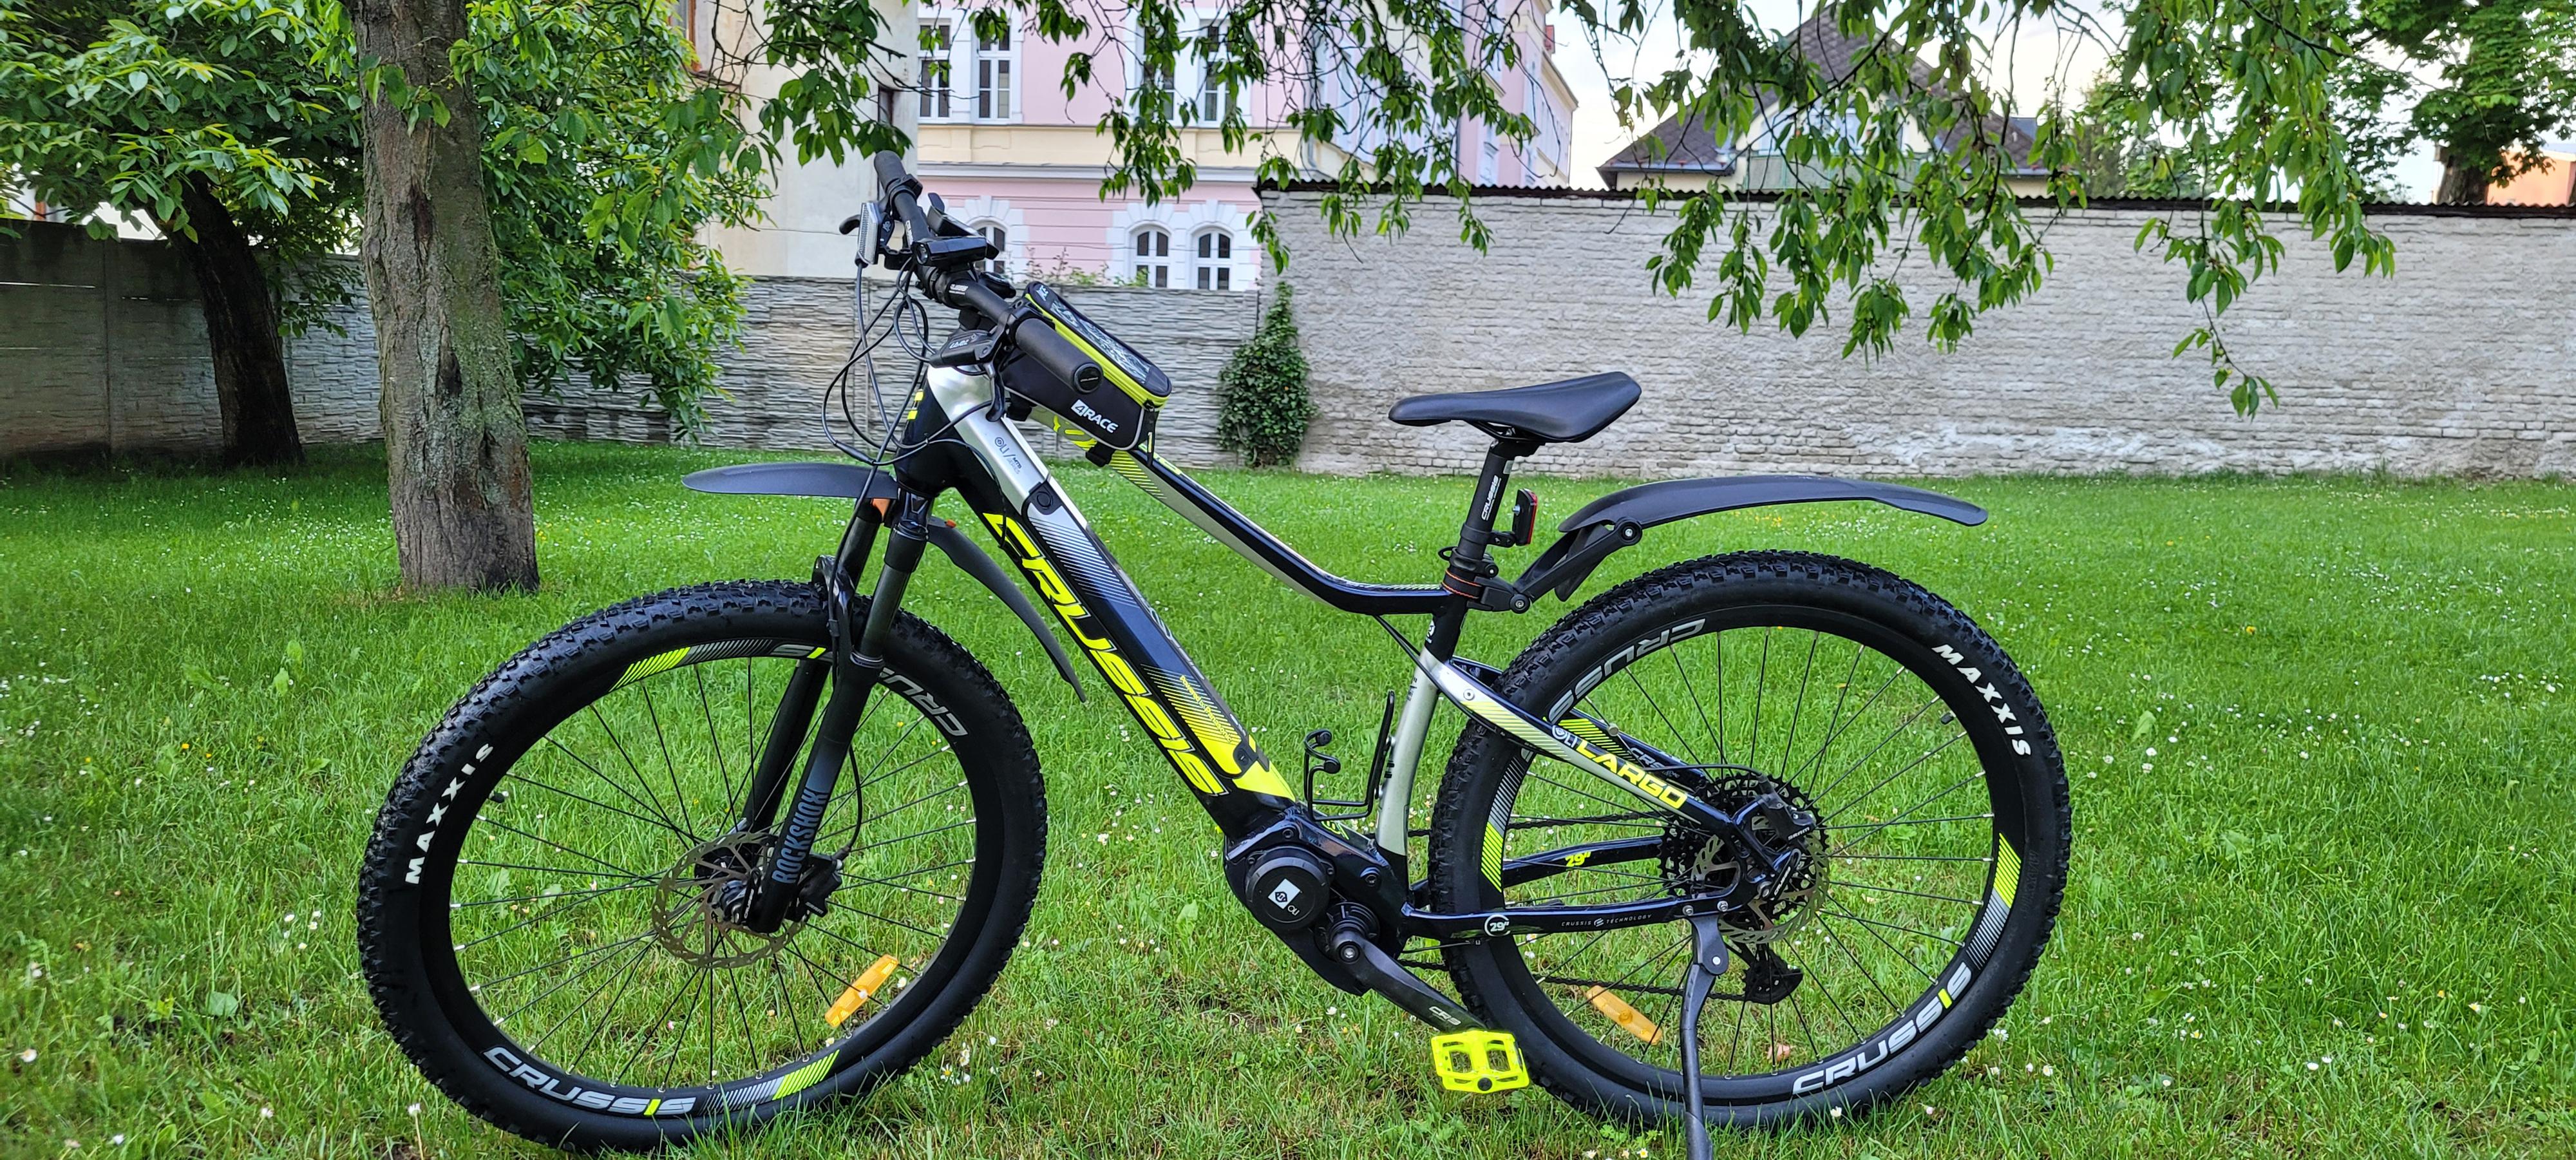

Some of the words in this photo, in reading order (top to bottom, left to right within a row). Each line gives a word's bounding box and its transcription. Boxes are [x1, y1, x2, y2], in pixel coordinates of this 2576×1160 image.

[1071, 399, 1119, 433] 4RACE
[1481, 475, 1499, 520] CRUSSIS
[982, 512, 1229, 797] CRUSSIS
[1204, 706, 1232, 743] Panasonic
[1932, 644, 2031, 756] MAXXIS
[1576, 739, 1688, 809] LARGO
[405, 743, 494, 884] MAXXIS
[772, 788, 830, 884] ROCKSHOX
[1606, 913, 1652, 924] TECHNOLOGY
[1792, 962, 1973, 1095] CRUSSIS
[483, 1047, 696, 1116] CRUSSIS
